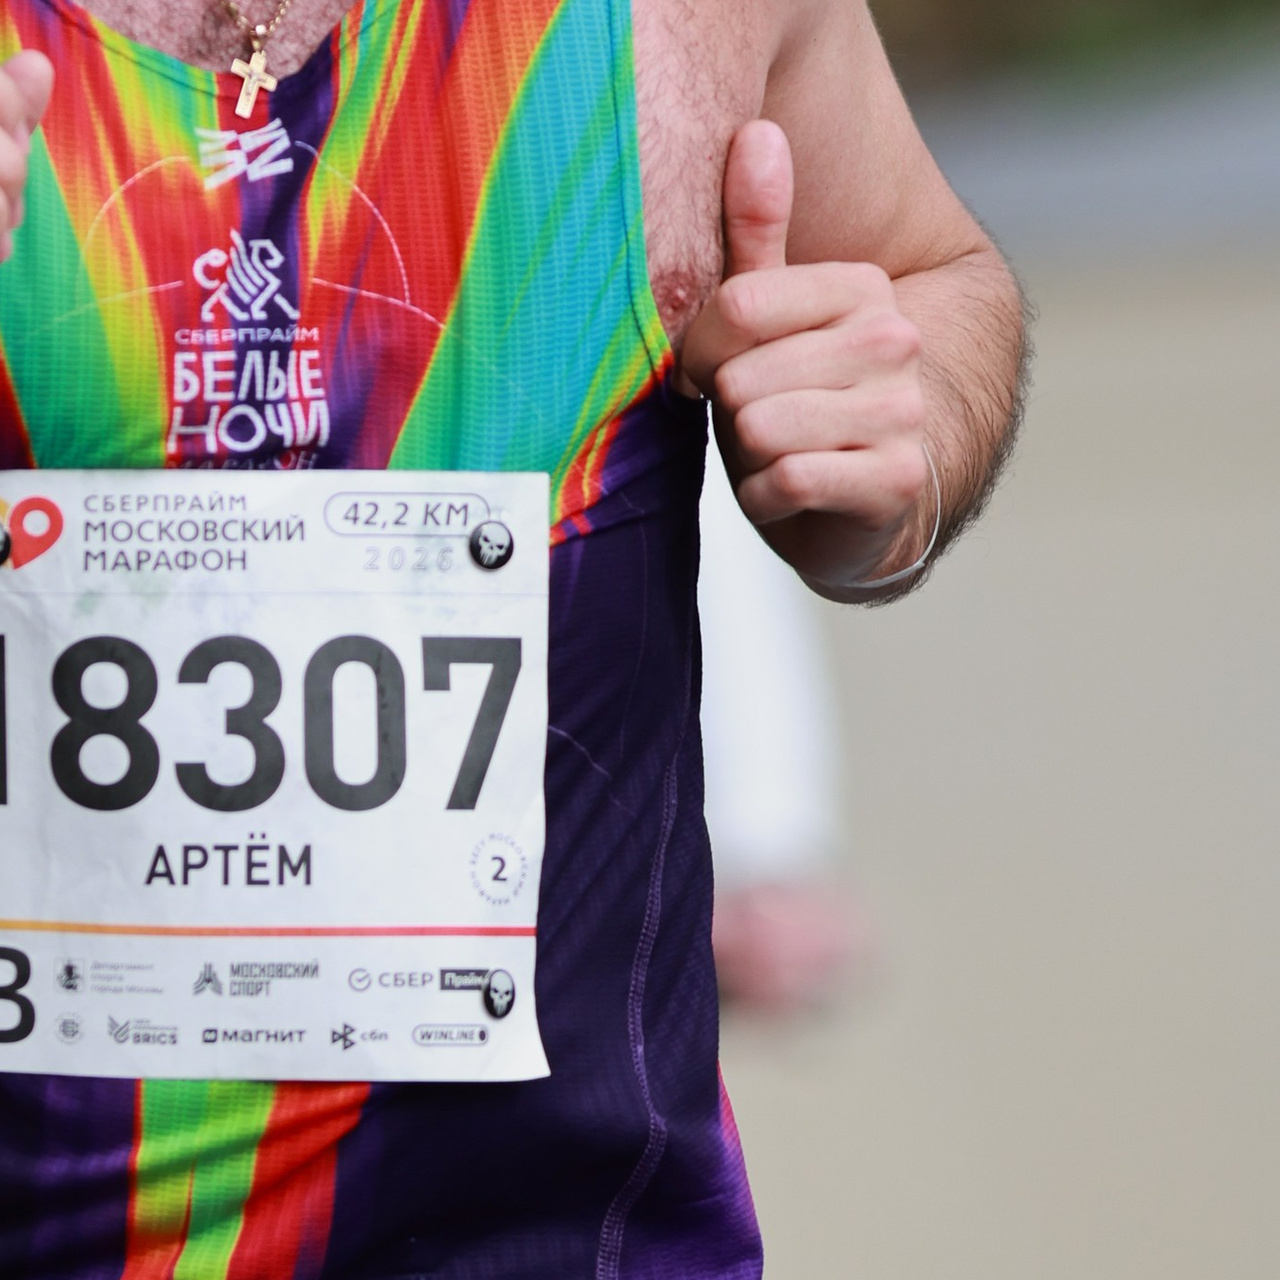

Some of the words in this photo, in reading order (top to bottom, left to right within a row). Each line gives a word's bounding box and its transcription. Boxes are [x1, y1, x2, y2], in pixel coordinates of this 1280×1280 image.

[174, 324, 320, 344] СБЕРПРАЙМ
[173, 350, 325, 402] БЕЛЫЕ
[167, 400, 331, 454] НОЧИ
[83, 492, 248, 512] СБЕРПРАЙМ
[343, 502, 409, 529] 42,2
[423, 502, 469, 526] КМ
[84, 514, 305, 542] МОСКОВСКИЙ
[84, 549, 247, 571] МАРАФОН
[363, 547, 454, 571] 2026
[144, 833, 312, 886] АРТЁМ
[491, 856, 507, 881] 2
[229, 958, 319, 978] МОСКОВСКИЙ
[229, 980, 271, 996] СПОРТ
[378, 972, 433, 987] СБЕР
[132, 1033, 177, 1044] BRICS
[222, 1029, 305, 1042] магнит
[420, 1031, 475, 1041] WINLINE
